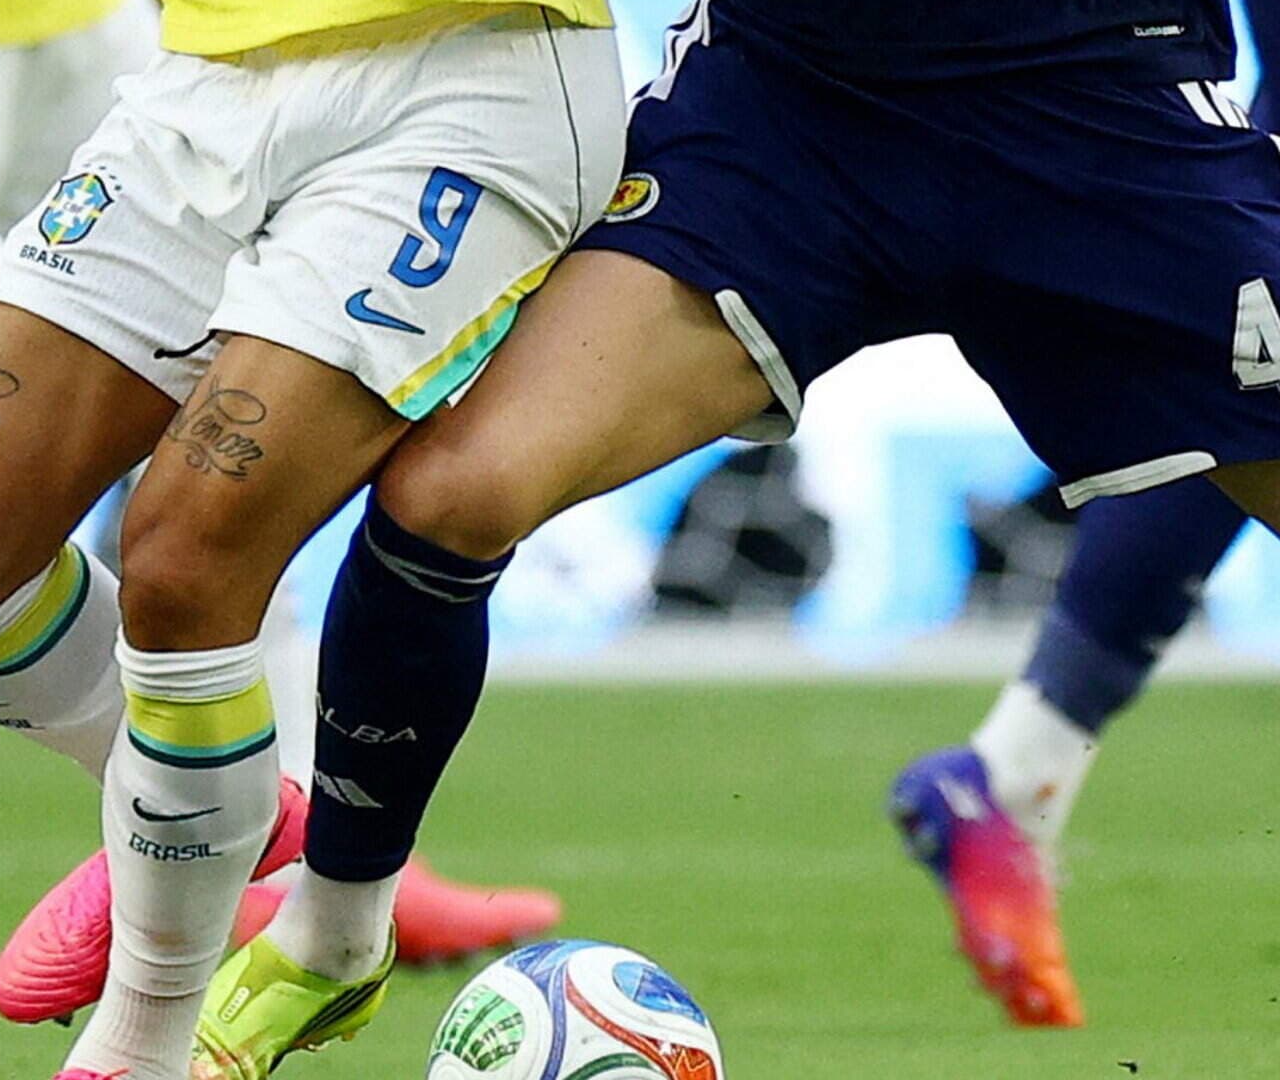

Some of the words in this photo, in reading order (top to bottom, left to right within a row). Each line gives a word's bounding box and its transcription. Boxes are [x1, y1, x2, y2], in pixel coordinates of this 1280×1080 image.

[387, 166, 485, 289] 9
[20, 244, 76, 276] BRASIL
[129, 832, 223, 862] BRASIL
